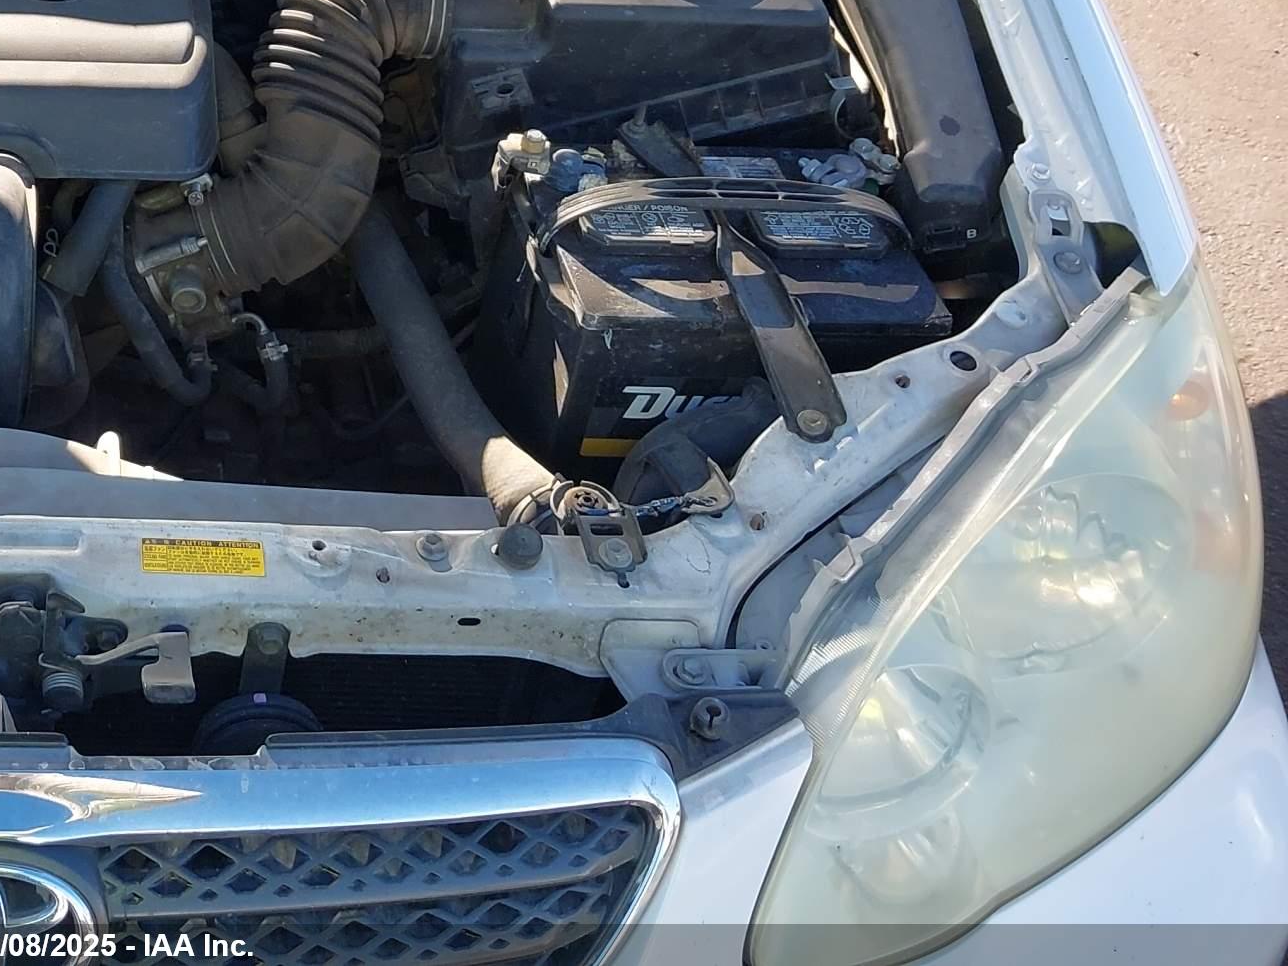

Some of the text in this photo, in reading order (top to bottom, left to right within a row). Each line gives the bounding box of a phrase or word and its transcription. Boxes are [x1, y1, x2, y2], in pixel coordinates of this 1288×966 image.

[966, 228, 977, 239] B
[175, 539, 212, 547] CAUTION
[218, 541, 259, 549] ATTENTION
